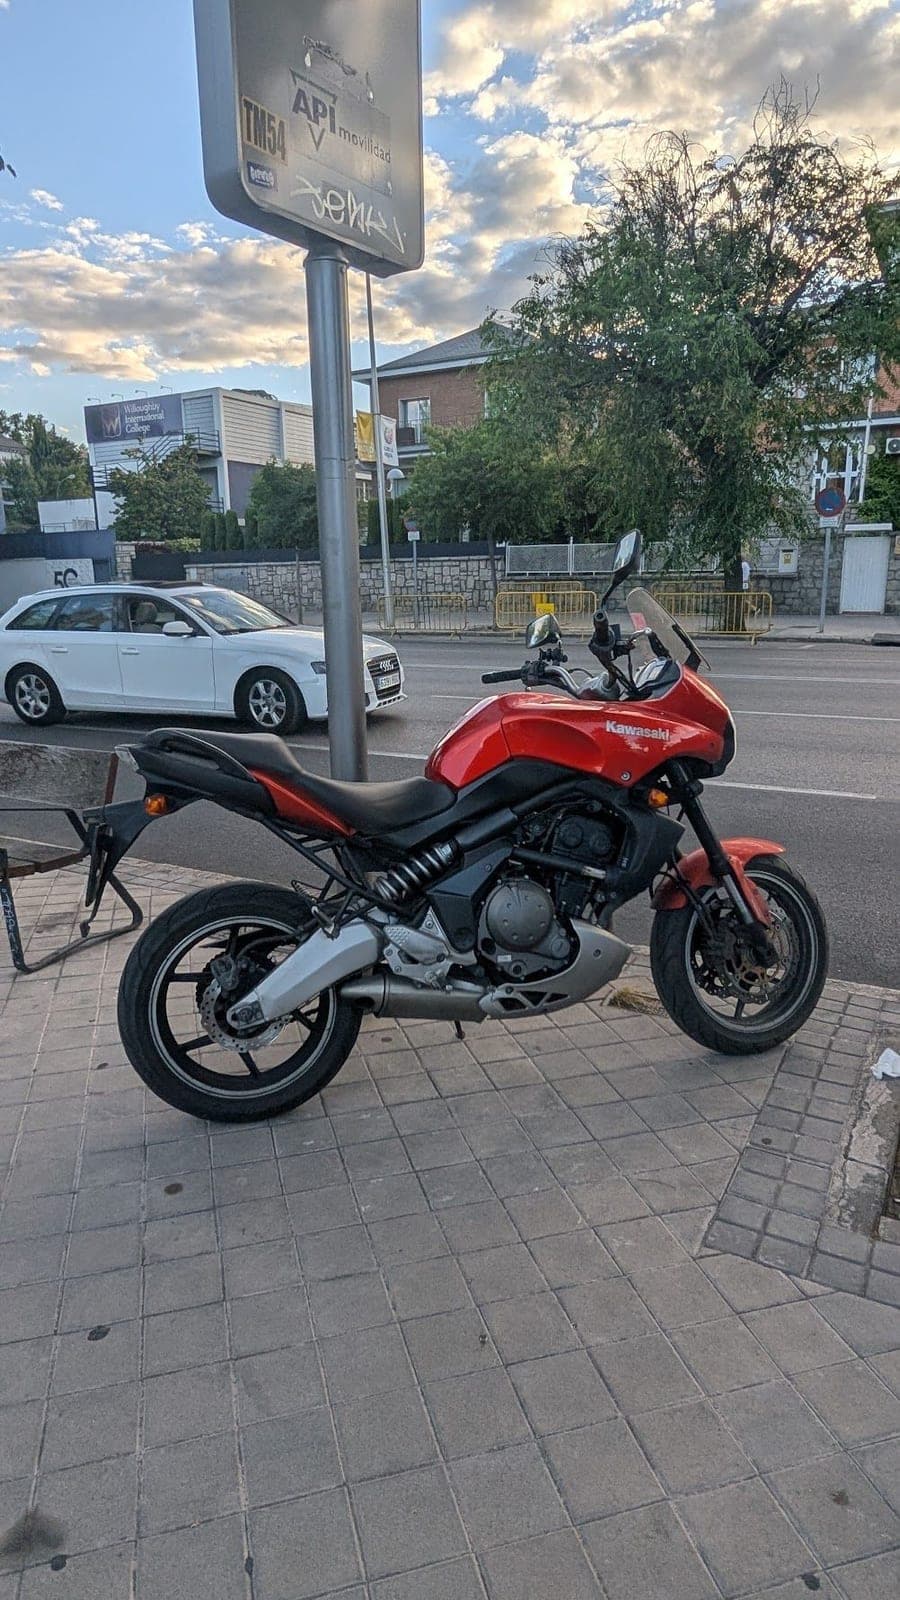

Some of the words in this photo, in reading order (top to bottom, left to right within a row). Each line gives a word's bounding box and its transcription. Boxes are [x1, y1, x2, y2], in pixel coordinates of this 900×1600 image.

[242, 97, 287, 161] TM54
[338, 126, 391, 164] movilidad
[123, 401, 161, 415] Willoughby
[124, 409, 165, 424] International
[125, 422, 151, 434] College
[605, 719, 670, 741] Kawasaki
